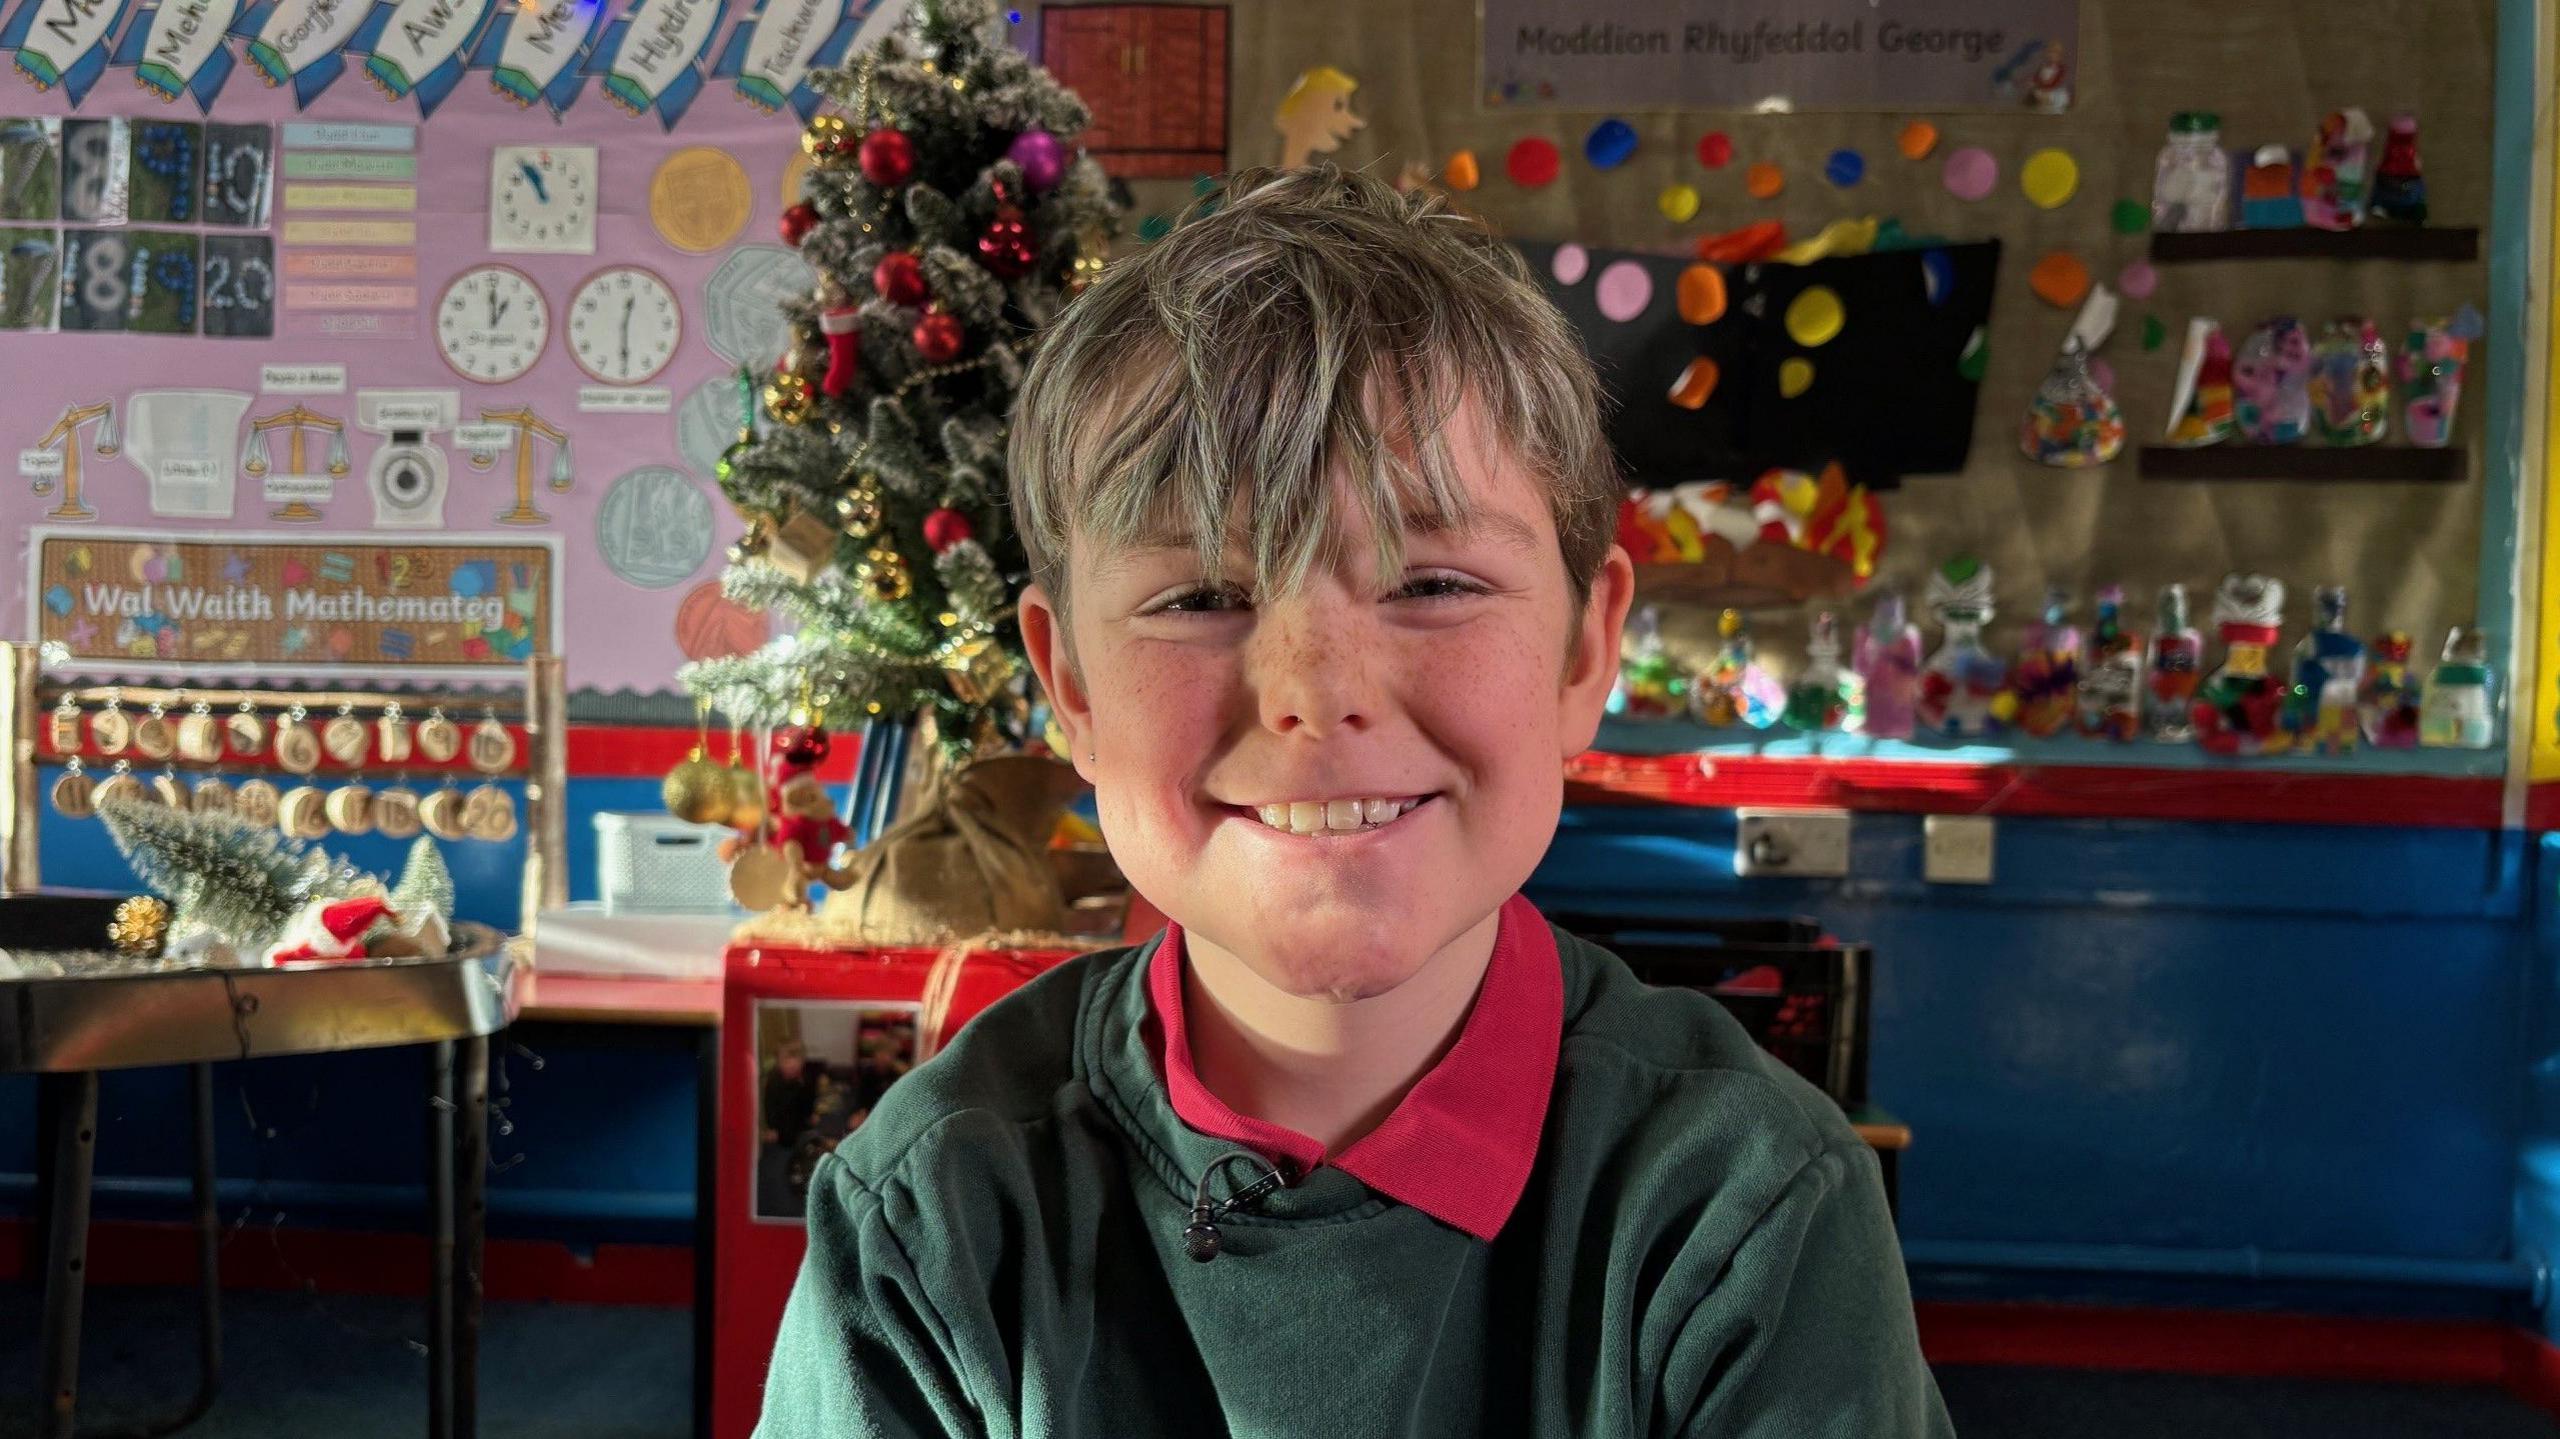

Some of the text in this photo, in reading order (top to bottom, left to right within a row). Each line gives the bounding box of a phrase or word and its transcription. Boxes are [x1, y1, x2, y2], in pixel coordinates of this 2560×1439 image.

[526, 0, 576, 54] Me
[1516, 20, 2005, 64] Moddion Rhyfeddol George
[138, 126, 192, 220] 9
[205, 255, 273, 311] 20
[84, 582, 505, 631] Wal Waith Mathemateg
